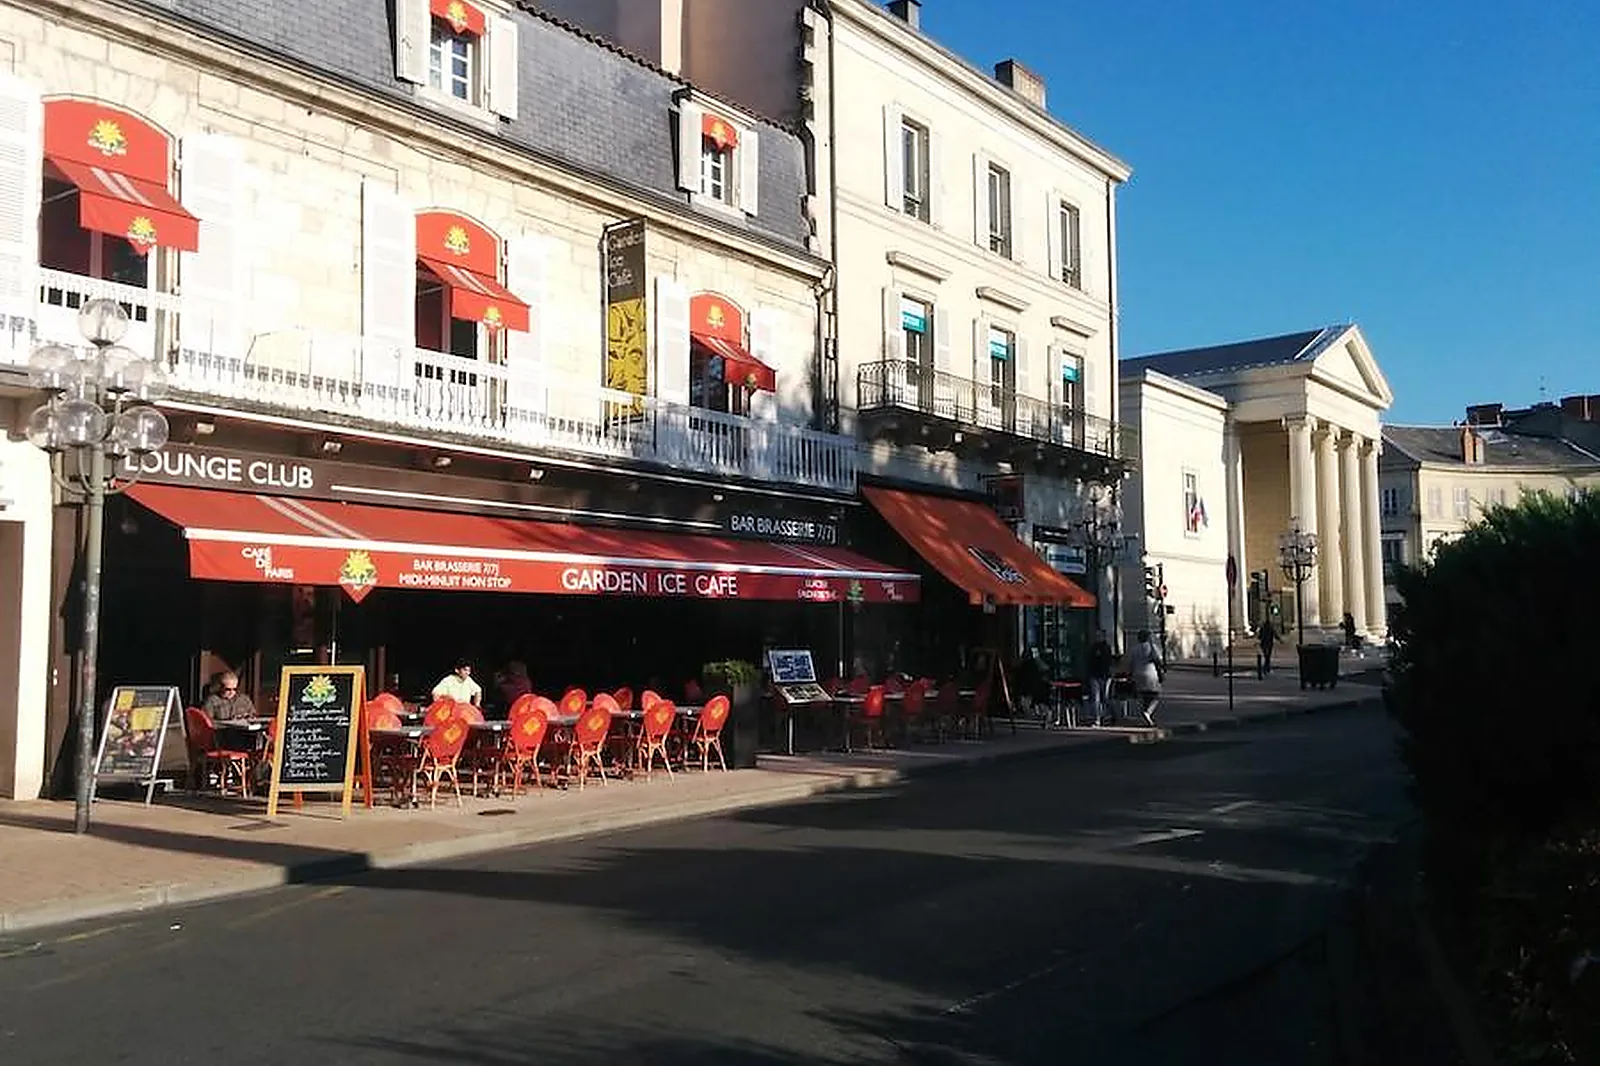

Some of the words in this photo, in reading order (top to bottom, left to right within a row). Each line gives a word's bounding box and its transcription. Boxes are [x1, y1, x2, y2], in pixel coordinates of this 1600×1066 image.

[124, 450, 243, 482] LOUNGE
[248, 461, 314, 489] CLUB
[731, 515, 756, 532] BAR
[756, 517, 816, 538] BRASSERIE
[264, 567, 294, 580] PARIS
[413, 559, 433, 572] BAR
[434, 560, 482, 574] BRASSERIE
[461, 576, 486, 588] NON
[486, 577, 512, 588] STOP
[561, 568, 647, 592] GARDEN
[657, 573, 686, 593] ICE
